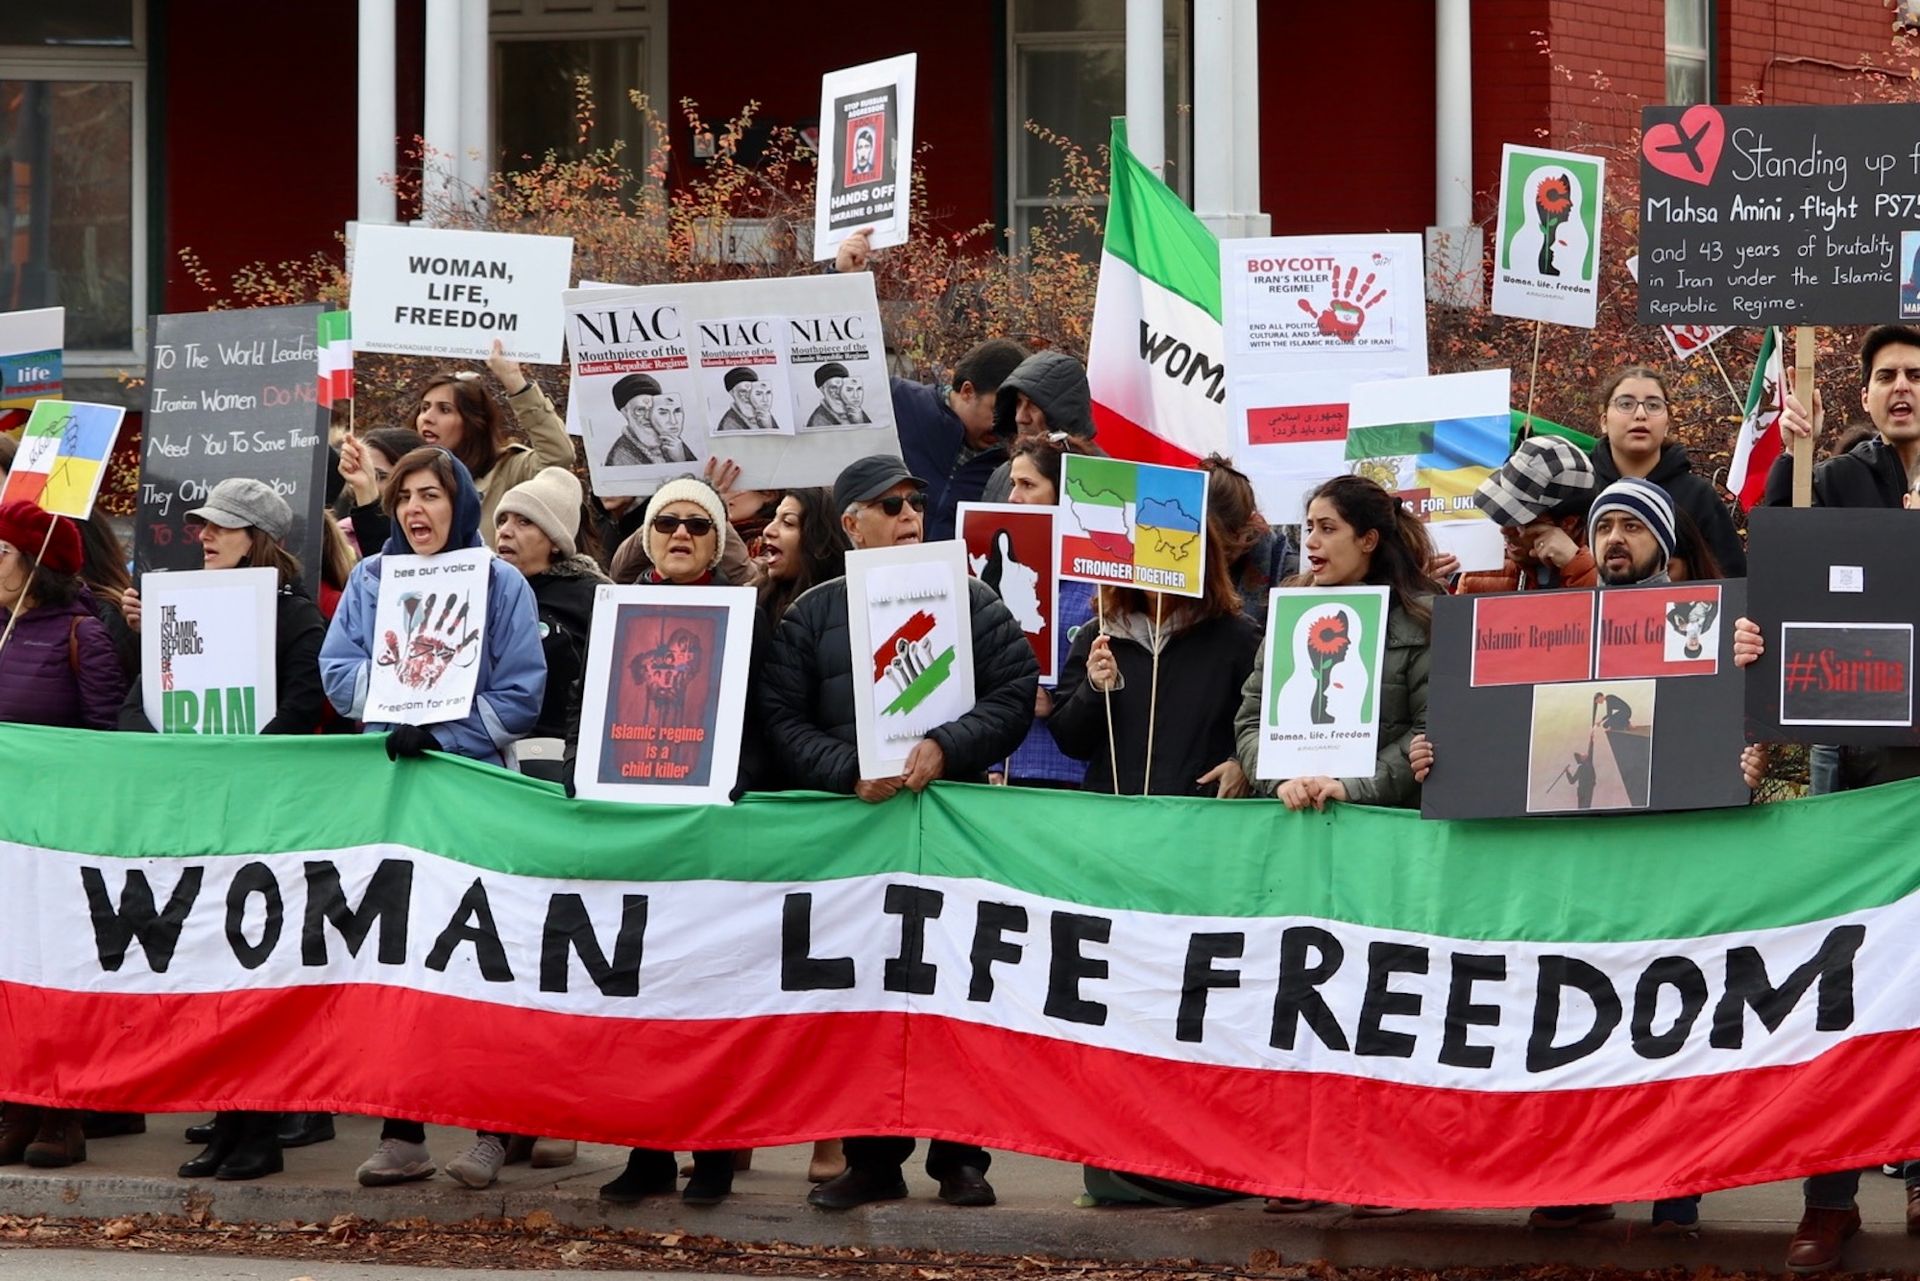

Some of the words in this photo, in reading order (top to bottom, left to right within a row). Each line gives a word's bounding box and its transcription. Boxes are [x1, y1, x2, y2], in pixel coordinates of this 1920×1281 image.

[1732, 127, 1848, 192] Standing
[1865, 154, 1897, 187] up
[831, 190, 869, 209] HANDS
[872, 184, 895, 199] OFF
[830, 207, 866, 223] UKRAINE
[874, 202, 894, 213] IRAN
[1647, 195, 1718, 223] Mahsa
[1800, 195, 1859, 231] flight
[1651, 239, 1687, 262] and
[1699, 241, 1724, 261] 43
[1736, 243, 1781, 269] years
[1797, 235, 1817, 257] of
[1826, 233, 1894, 268] brutality
[409, 256, 514, 284] WOMAN,
[1248, 258, 1335, 273] BOYCOTT
[1254, 275, 1290, 284] IRAN'S
[1294, 274, 1329, 282] KILLER
[1650, 273, 1664, 287] in
[1676, 269, 1713, 288] Iran
[1727, 269, 1776, 286] under
[1791, 266, 1819, 285] the
[1831, 266, 1893, 285] Islamic
[428, 283, 489, 307] LIFE,
[1269, 284, 1314, 293] REGIME!
[394, 306, 518, 331] FREEDOM
[1650, 297, 1718, 317] Republic
[1733, 296, 1804, 319] Regime.
[573, 305, 681, 346] NIAC
[699, 320, 772, 348] NIAC
[790, 315, 864, 343] NIAC
[1249, 323, 1267, 331] END
[184, 343, 209, 368] The
[217, 341, 265, 366] World
[271, 335, 319, 363] Leaders
[434, 345, 447, 353] FOR
[449, 346, 472, 355] JUSTICE
[518, 351, 541, 359] RIGHTS
[578, 349, 649, 362] Mouthpiece
[651, 345, 665, 357] of
[666, 344, 686, 355] the
[701, 349, 749, 358] Mouthpiece
[751, 348, 760, 356] of
[763, 347, 775, 355] the
[791, 345, 841, 355] Mouthpiece
[1250, 340, 1271, 348] WITH
[579, 362, 613, 373] Islamic
[614, 360, 654, 372] Republic
[655, 358, 689, 370] Regime
[1140, 319, 1225, 404] WOM
[18, 367, 50, 383] life
[150, 388, 198, 413] Iranian
[201, 389, 257, 412] Women
[263, 385, 290, 406] Do
[294, 383, 317, 402] No
[1269, 411, 1300, 426] اسلامی
[147, 435, 192, 457] Need
[201, 434, 227, 455] You
[229, 431, 249, 452] To
[252, 431, 286, 452] Save
[288, 429, 319, 448] Them
[143, 483, 172, 516] They
[394, 568, 415, 578] bee
[419, 566, 439, 576] our
[443, 563, 476, 573] voice
[1073, 557, 1133, 579] STRONGER
[1135, 566, 1186, 588] TOGETHER
[161, 605, 176, 621] THE
[161, 620, 197, 639] ISLAMIC
[1476, 625, 1525, 651] Islamic
[1529, 622, 1585, 652] Republic
[1644, 616, 1665, 645] Go
[161, 637, 204, 656] REPUBLIC
[162, 673, 174, 691] VS
[1785, 649, 1905, 694] #Sarina
[162, 686, 256, 735] IRAN
[378, 702, 423, 713] freedom
[427, 699, 443, 709] for
[611, 723, 656, 741] Islamic
[659, 725, 705, 744] regime
[645, 744, 657, 759] is
[661, 748, 669, 759] a
[621, 762, 651, 778] child
[655, 763, 689, 779] killer
[81, 859, 648, 997] WOMAN
[781, 884, 1112, 1026] LIFE
[1176, 924, 1866, 1073] FREEDOM
